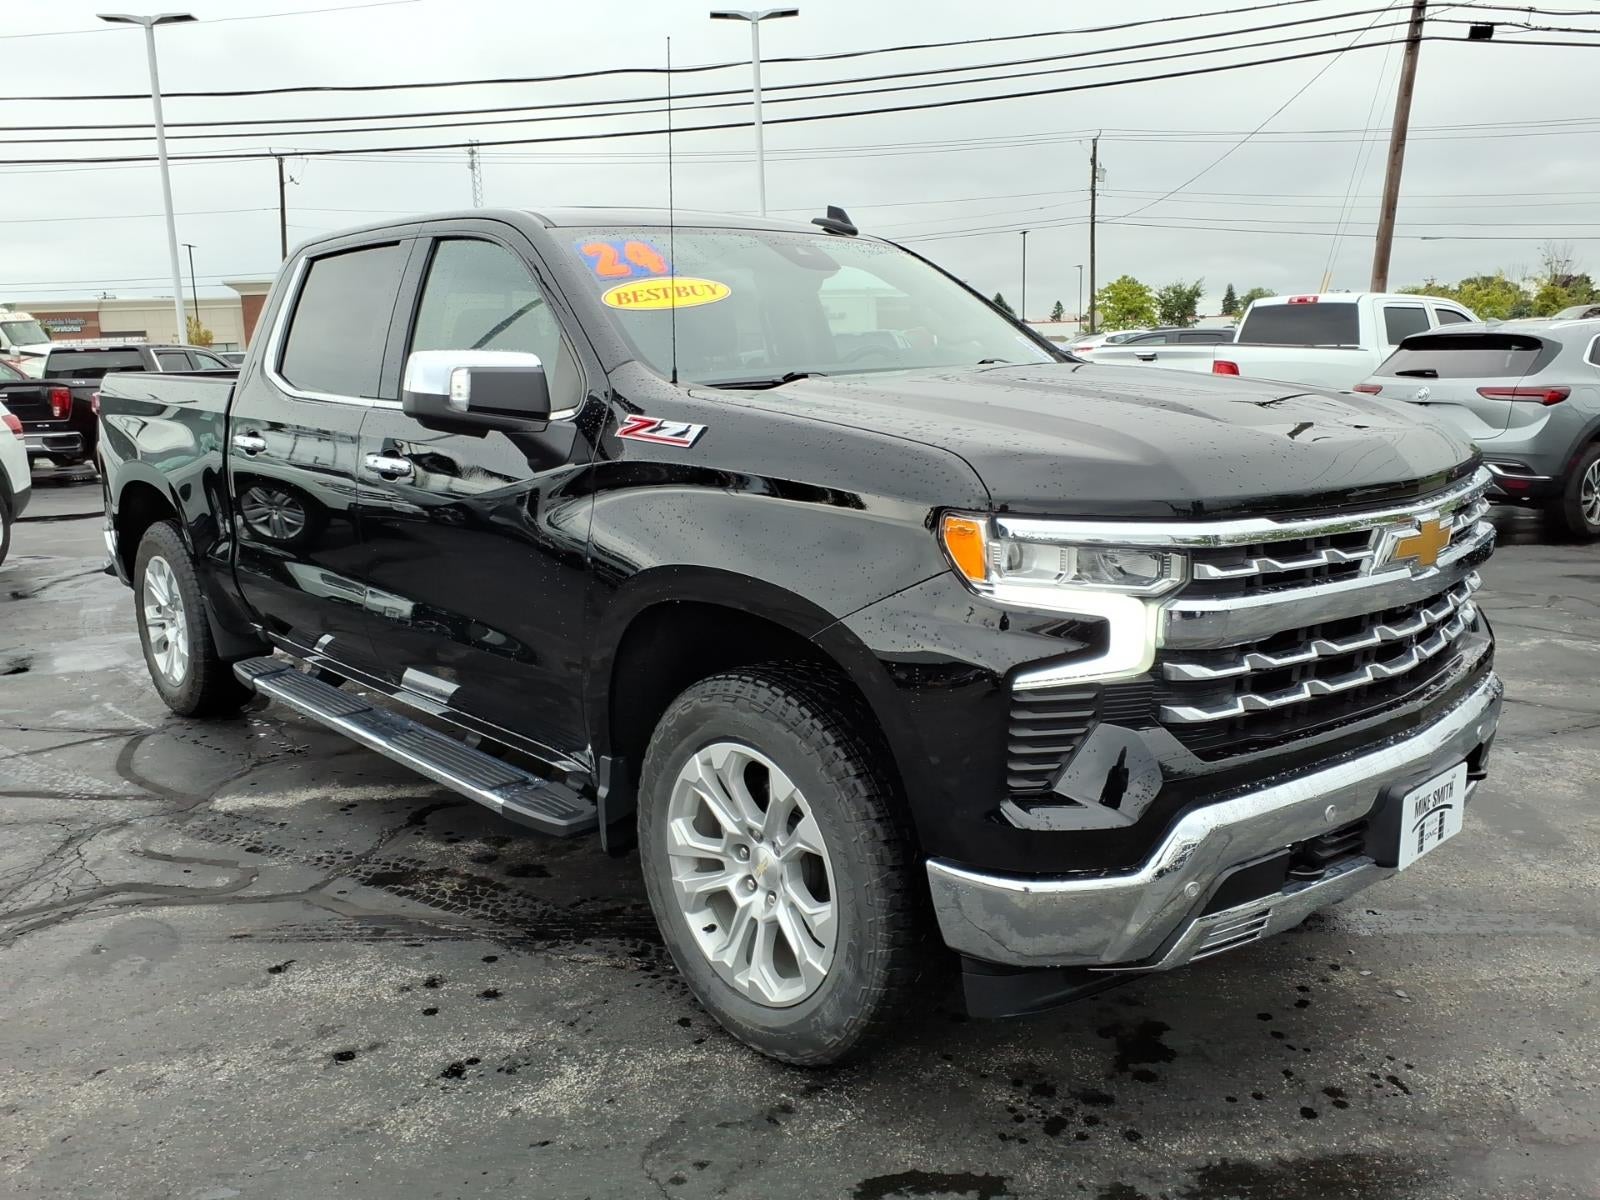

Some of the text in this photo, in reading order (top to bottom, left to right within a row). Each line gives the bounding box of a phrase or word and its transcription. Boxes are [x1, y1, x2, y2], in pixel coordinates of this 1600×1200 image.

[581, 240, 668, 277] 24
[615, 283, 719, 305] BEST BUY
[615, 414, 709, 448] Z71
[1415, 782, 1454, 818] MIKE SMITH
